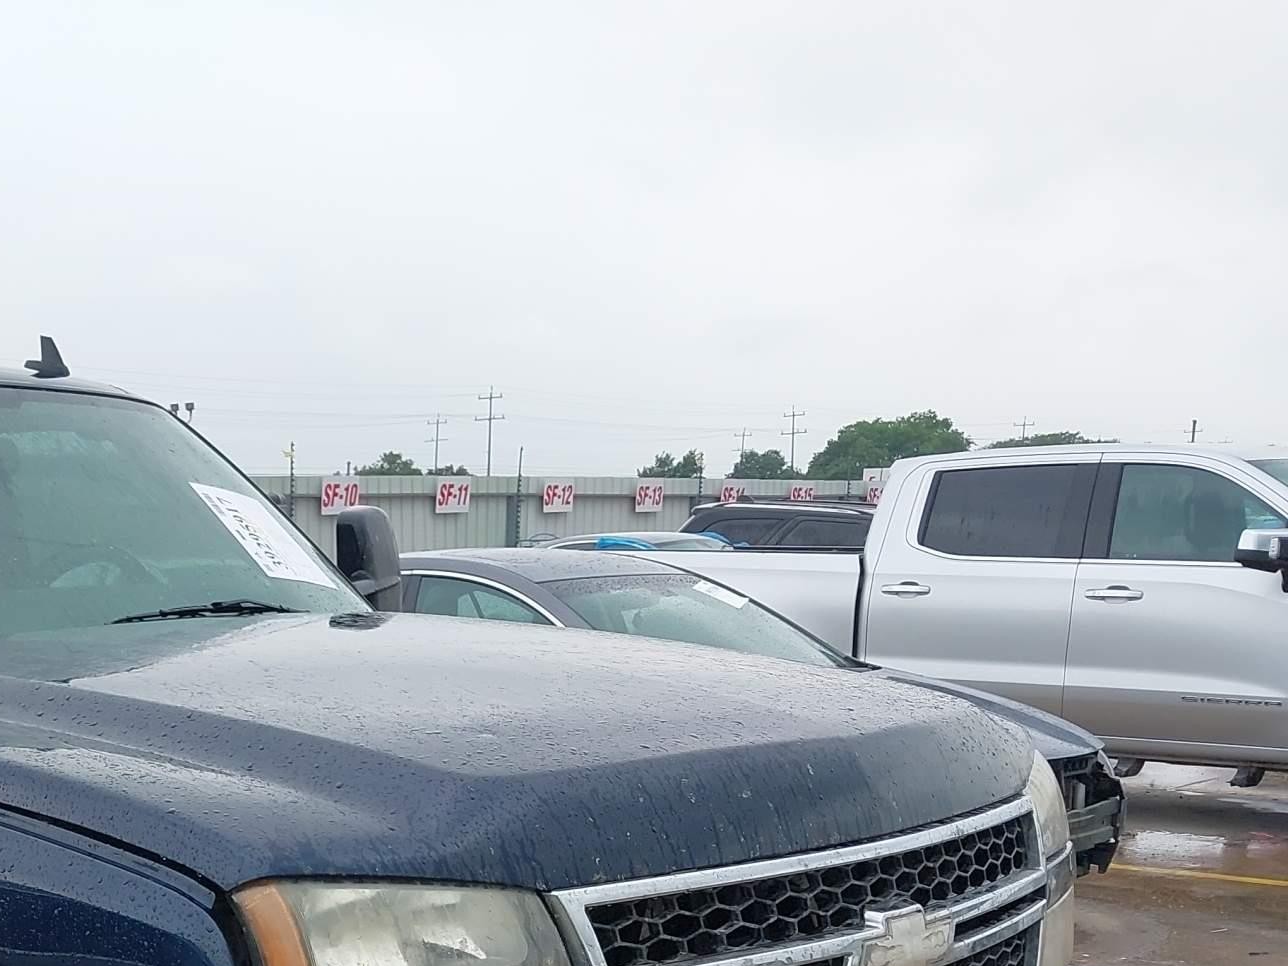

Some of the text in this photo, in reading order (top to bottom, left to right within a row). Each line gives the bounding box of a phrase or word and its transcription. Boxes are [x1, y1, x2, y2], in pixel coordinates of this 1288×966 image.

[322, 483, 358, 508] SF-10
[438, 484, 469, 506] SF-11
[544, 485, 573, 506] SF-12
[636, 486, 663, 506] SF-13
[791, 486, 814, 501] SF-15
